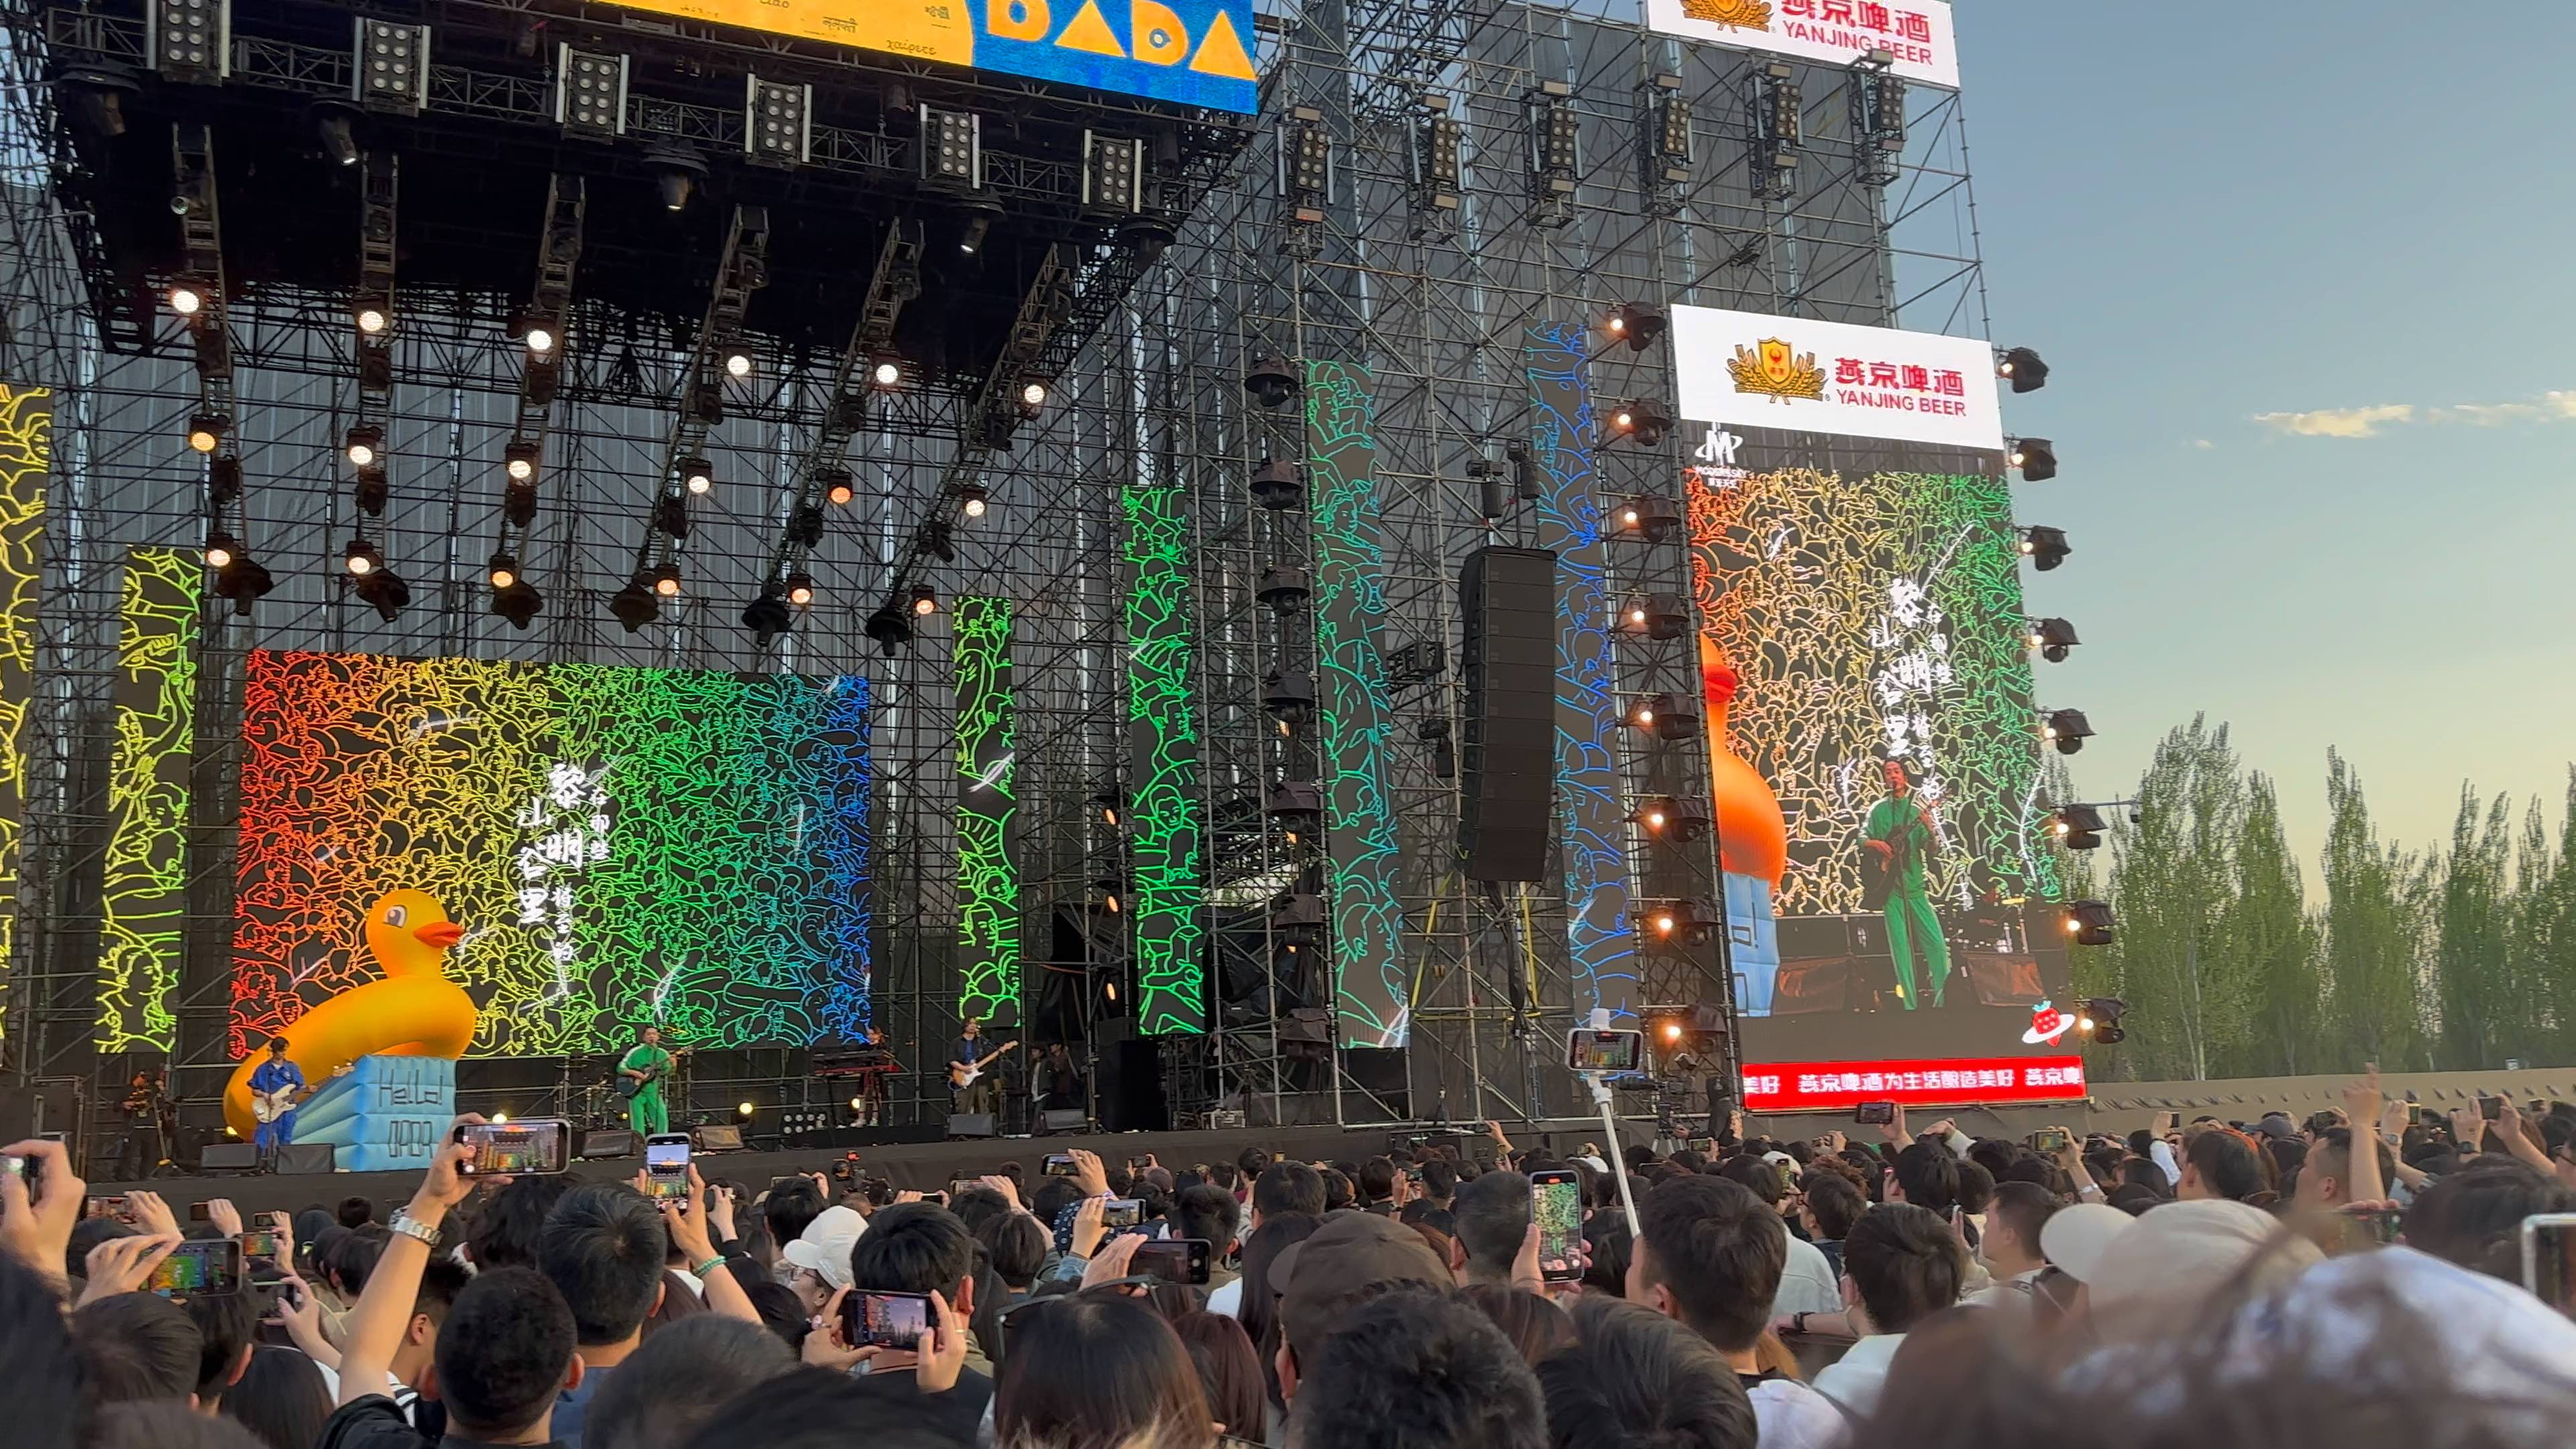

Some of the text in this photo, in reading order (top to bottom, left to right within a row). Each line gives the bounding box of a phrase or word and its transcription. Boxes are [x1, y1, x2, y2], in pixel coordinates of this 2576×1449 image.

[1782, 20, 1933, 66] YANJING BEER
[1835, 357, 1965, 397] 燕京啤酒
[1836, 388, 1967, 417] YANJING BEER
